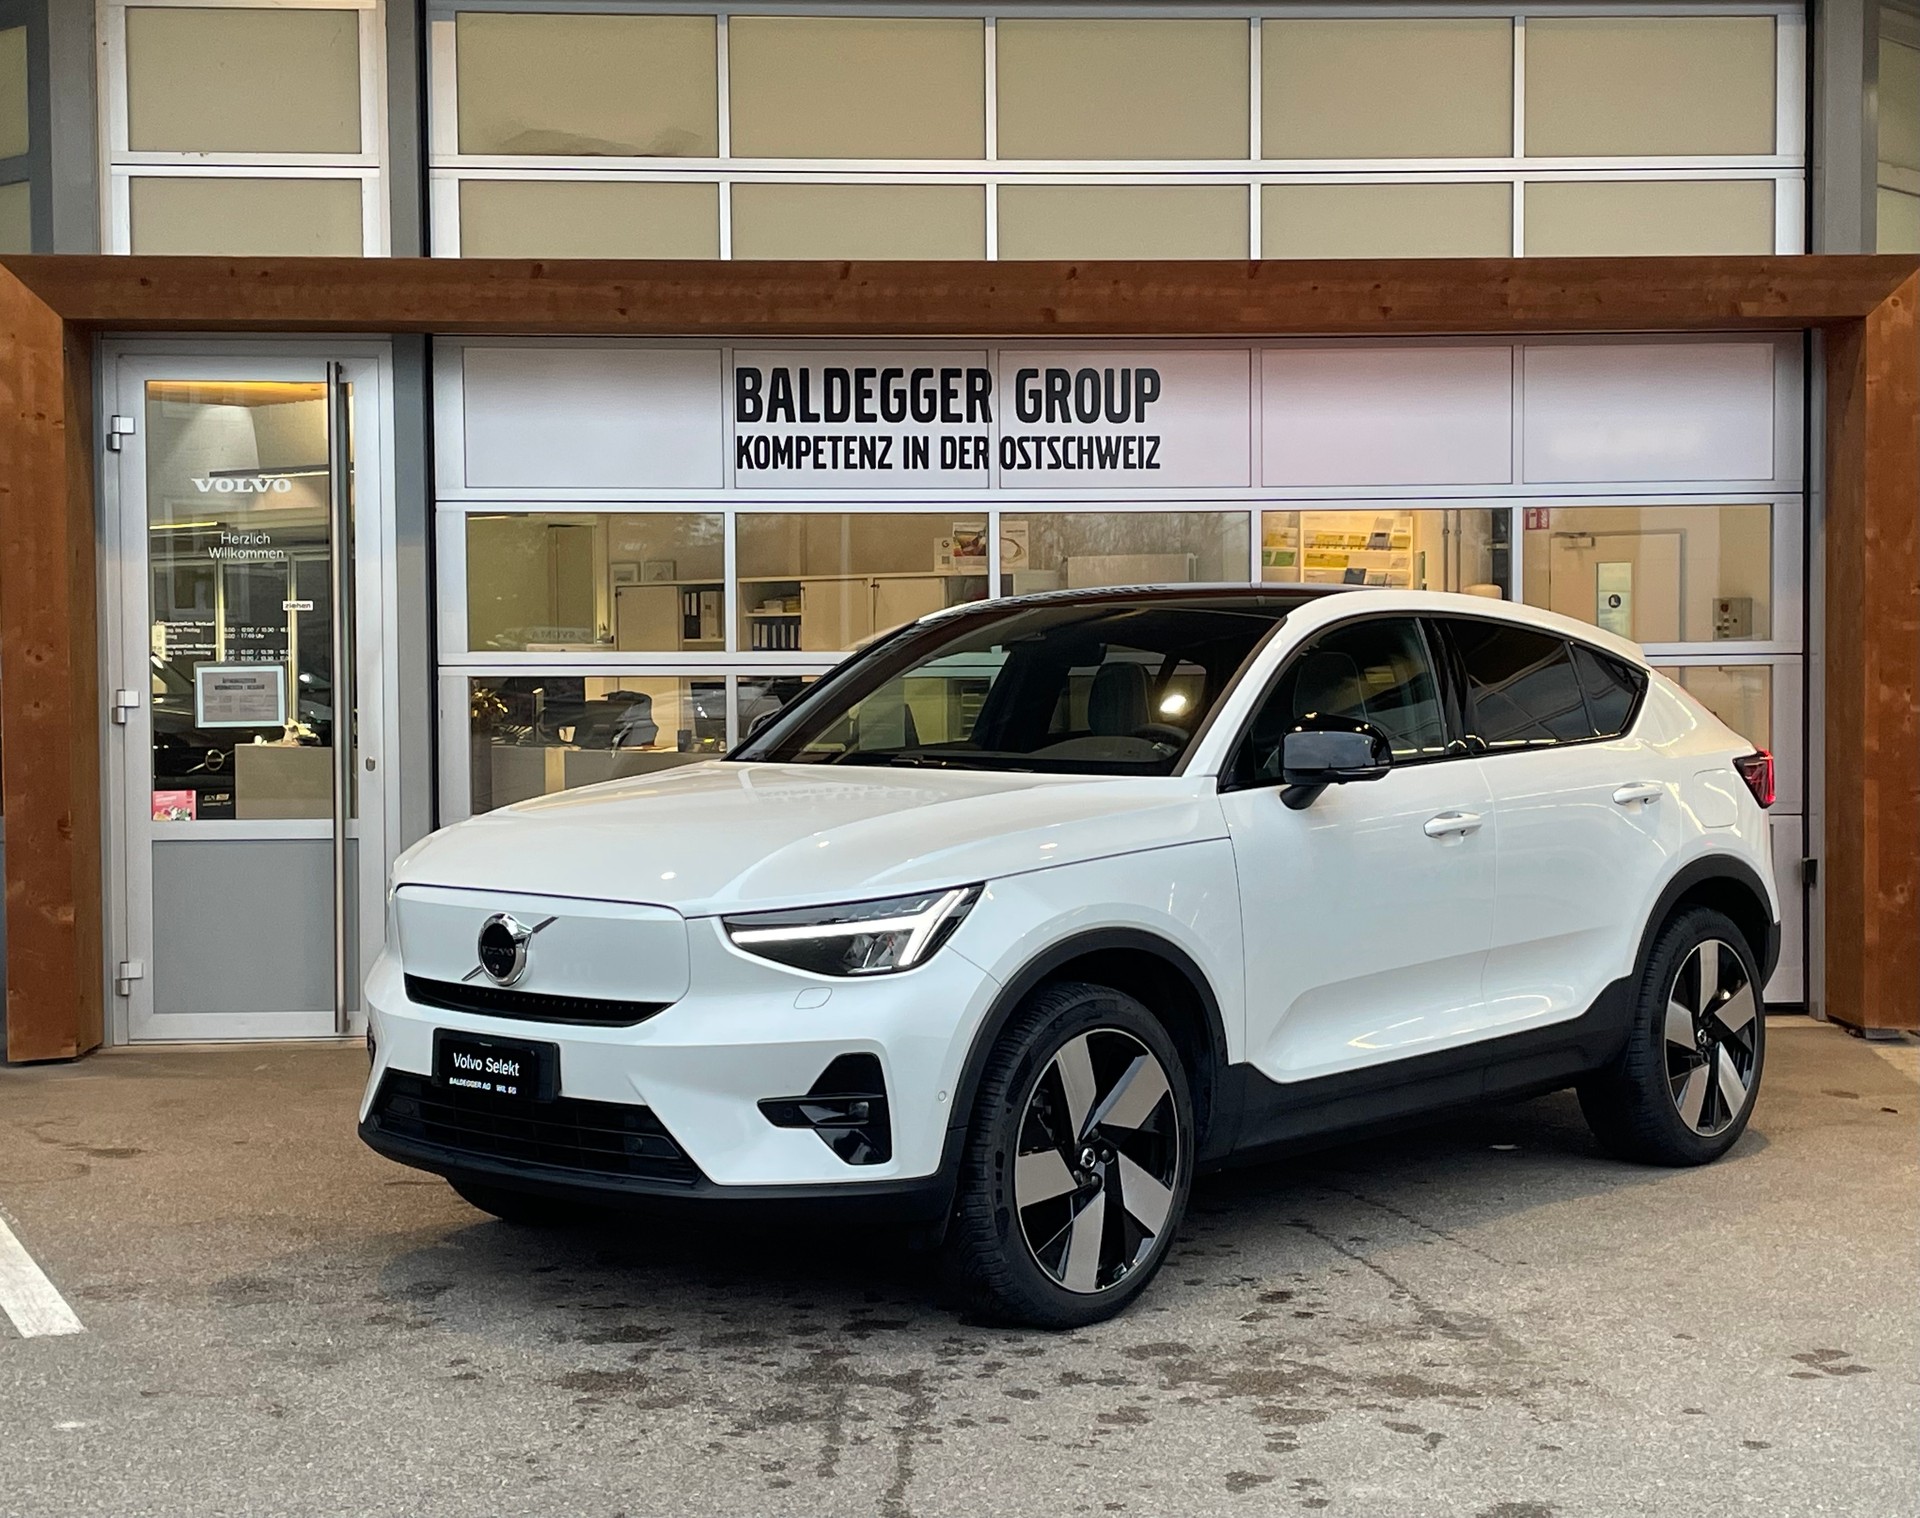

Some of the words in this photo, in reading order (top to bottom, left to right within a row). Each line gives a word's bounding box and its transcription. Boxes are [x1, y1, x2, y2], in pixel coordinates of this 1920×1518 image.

[735, 367, 993, 424] BALDEGGER
[1015, 367, 1161, 424] GROUP
[736, 435, 893, 470] KOMPETENZ
[903, 435, 930, 470] IN
[940, 435, 990, 470] DER
[1000, 435, 1161, 470] OSTSCHWEIZ
[191, 477, 292, 493] VOLVO
[220, 532, 271, 545] Herzlich
[208, 546, 284, 559] Willkommen
[453, 1052, 483, 1071] Volvo
[485, 1057, 520, 1076] Selekt
